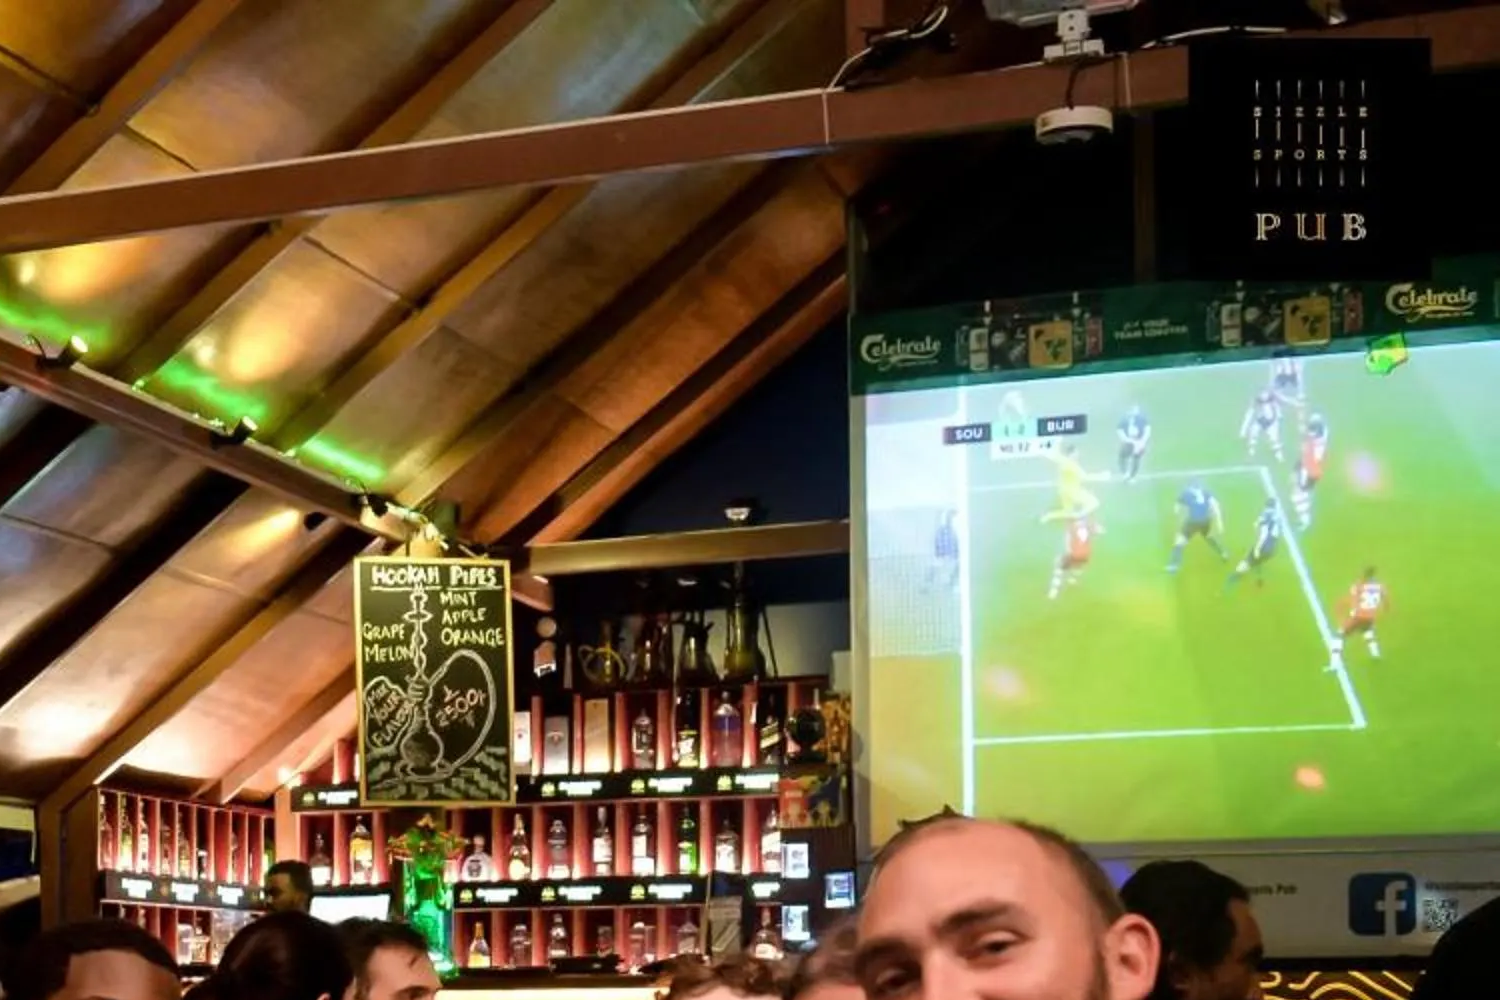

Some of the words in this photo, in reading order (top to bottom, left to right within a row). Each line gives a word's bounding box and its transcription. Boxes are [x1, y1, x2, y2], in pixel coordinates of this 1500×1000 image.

[955, 427, 983, 440] SOU
[371, 565, 441, 585] HOOKAH
[451, 565, 497, 586] PIPES
[440, 591, 477, 606] MINT
[442, 608, 487, 625] APPLE
[363, 623, 405, 640] GRAPE
[441, 628, 504, 648] ORANGE
[364, 645, 415, 663] MELON
